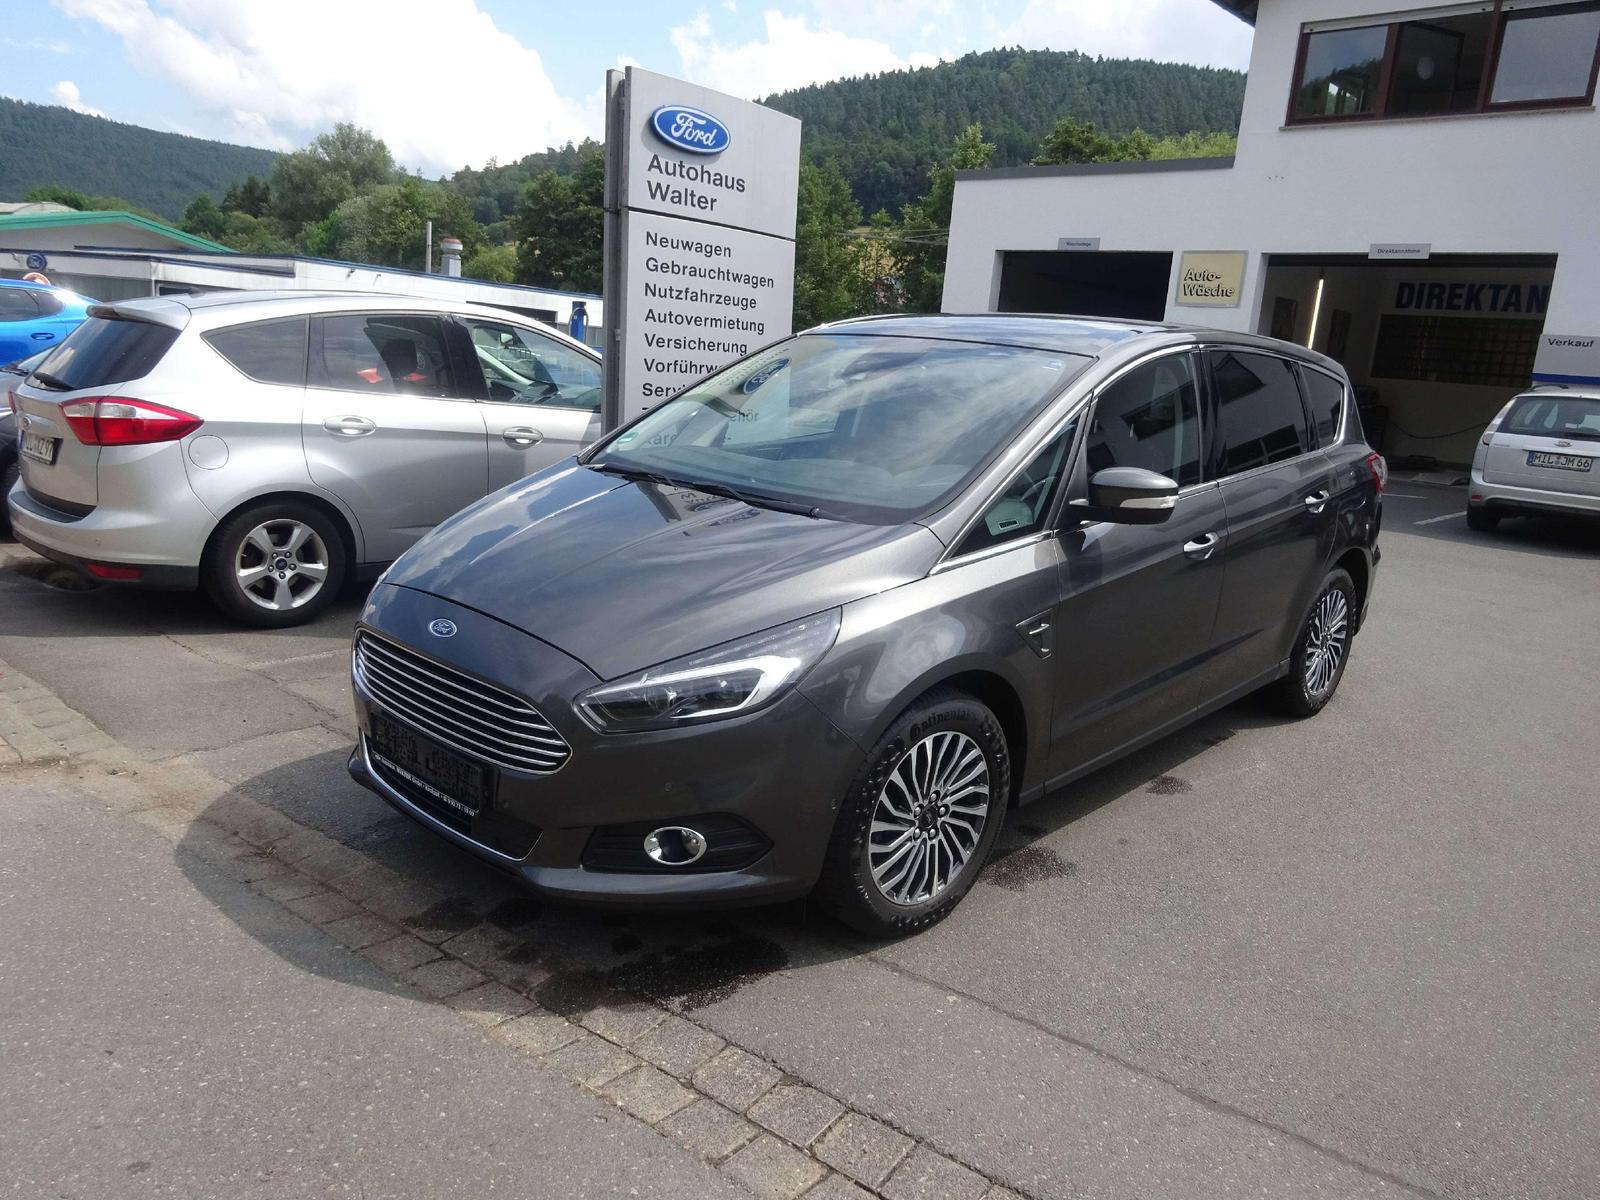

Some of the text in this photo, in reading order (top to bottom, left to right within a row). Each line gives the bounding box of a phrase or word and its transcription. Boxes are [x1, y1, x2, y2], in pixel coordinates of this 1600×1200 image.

[671, 112, 718, 147] Ford
[647, 154, 746, 193] Autohaus
[647, 180, 717, 212] Walter
[646, 231, 732, 258] Neuwagen
[645, 257, 775, 289] Gebrauchtwagen
[1184, 268, 1222, 282] Auto-
[644, 282, 757, 310] Nutzfahrzeuge
[1183, 283, 1235, 298] Wäsche
[644, 309, 765, 335] Autovermietung
[644, 333, 748, 356] Versicherung
[1547, 338, 1594, 348] Verkauf
[642, 383, 686, 397] Serv
[1533, 454, 1554, 465] MIL
